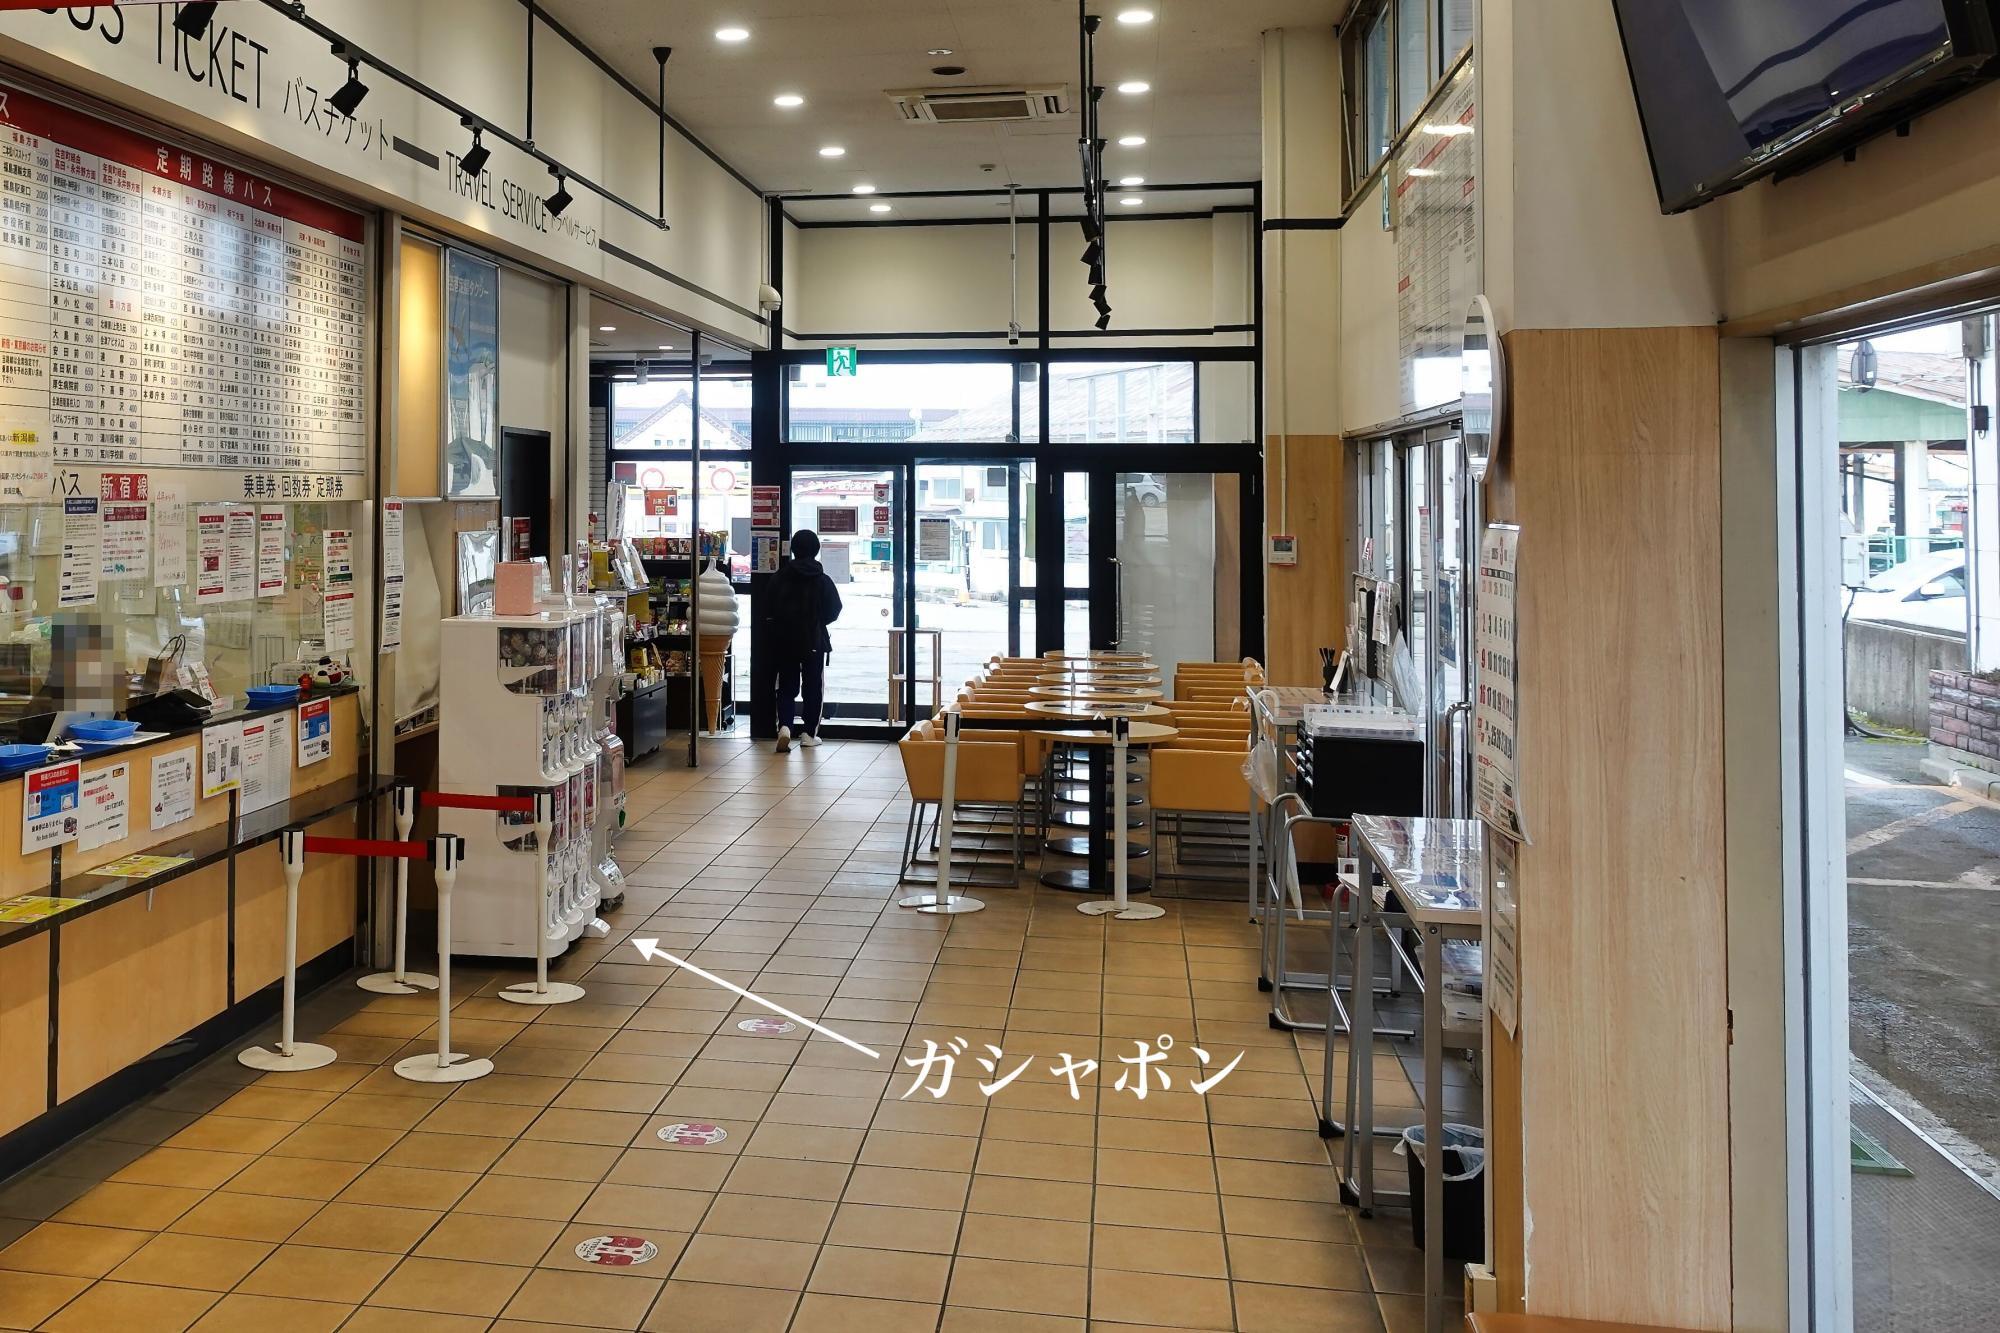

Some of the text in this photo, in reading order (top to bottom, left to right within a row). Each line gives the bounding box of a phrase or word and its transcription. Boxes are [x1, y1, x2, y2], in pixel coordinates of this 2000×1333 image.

[283, 77, 389, 161] バスチケット
[156, 146, 273, 207] 定期路線バス
[445, 150, 548, 234] TRAVEL SERVICE
[51, 470, 82, 496] バス
[101, 474, 149, 500] 新宿線
[243, 474, 345, 499] 乗車券・回数券・定期券
[1481, 648, 1486, 668] 9
